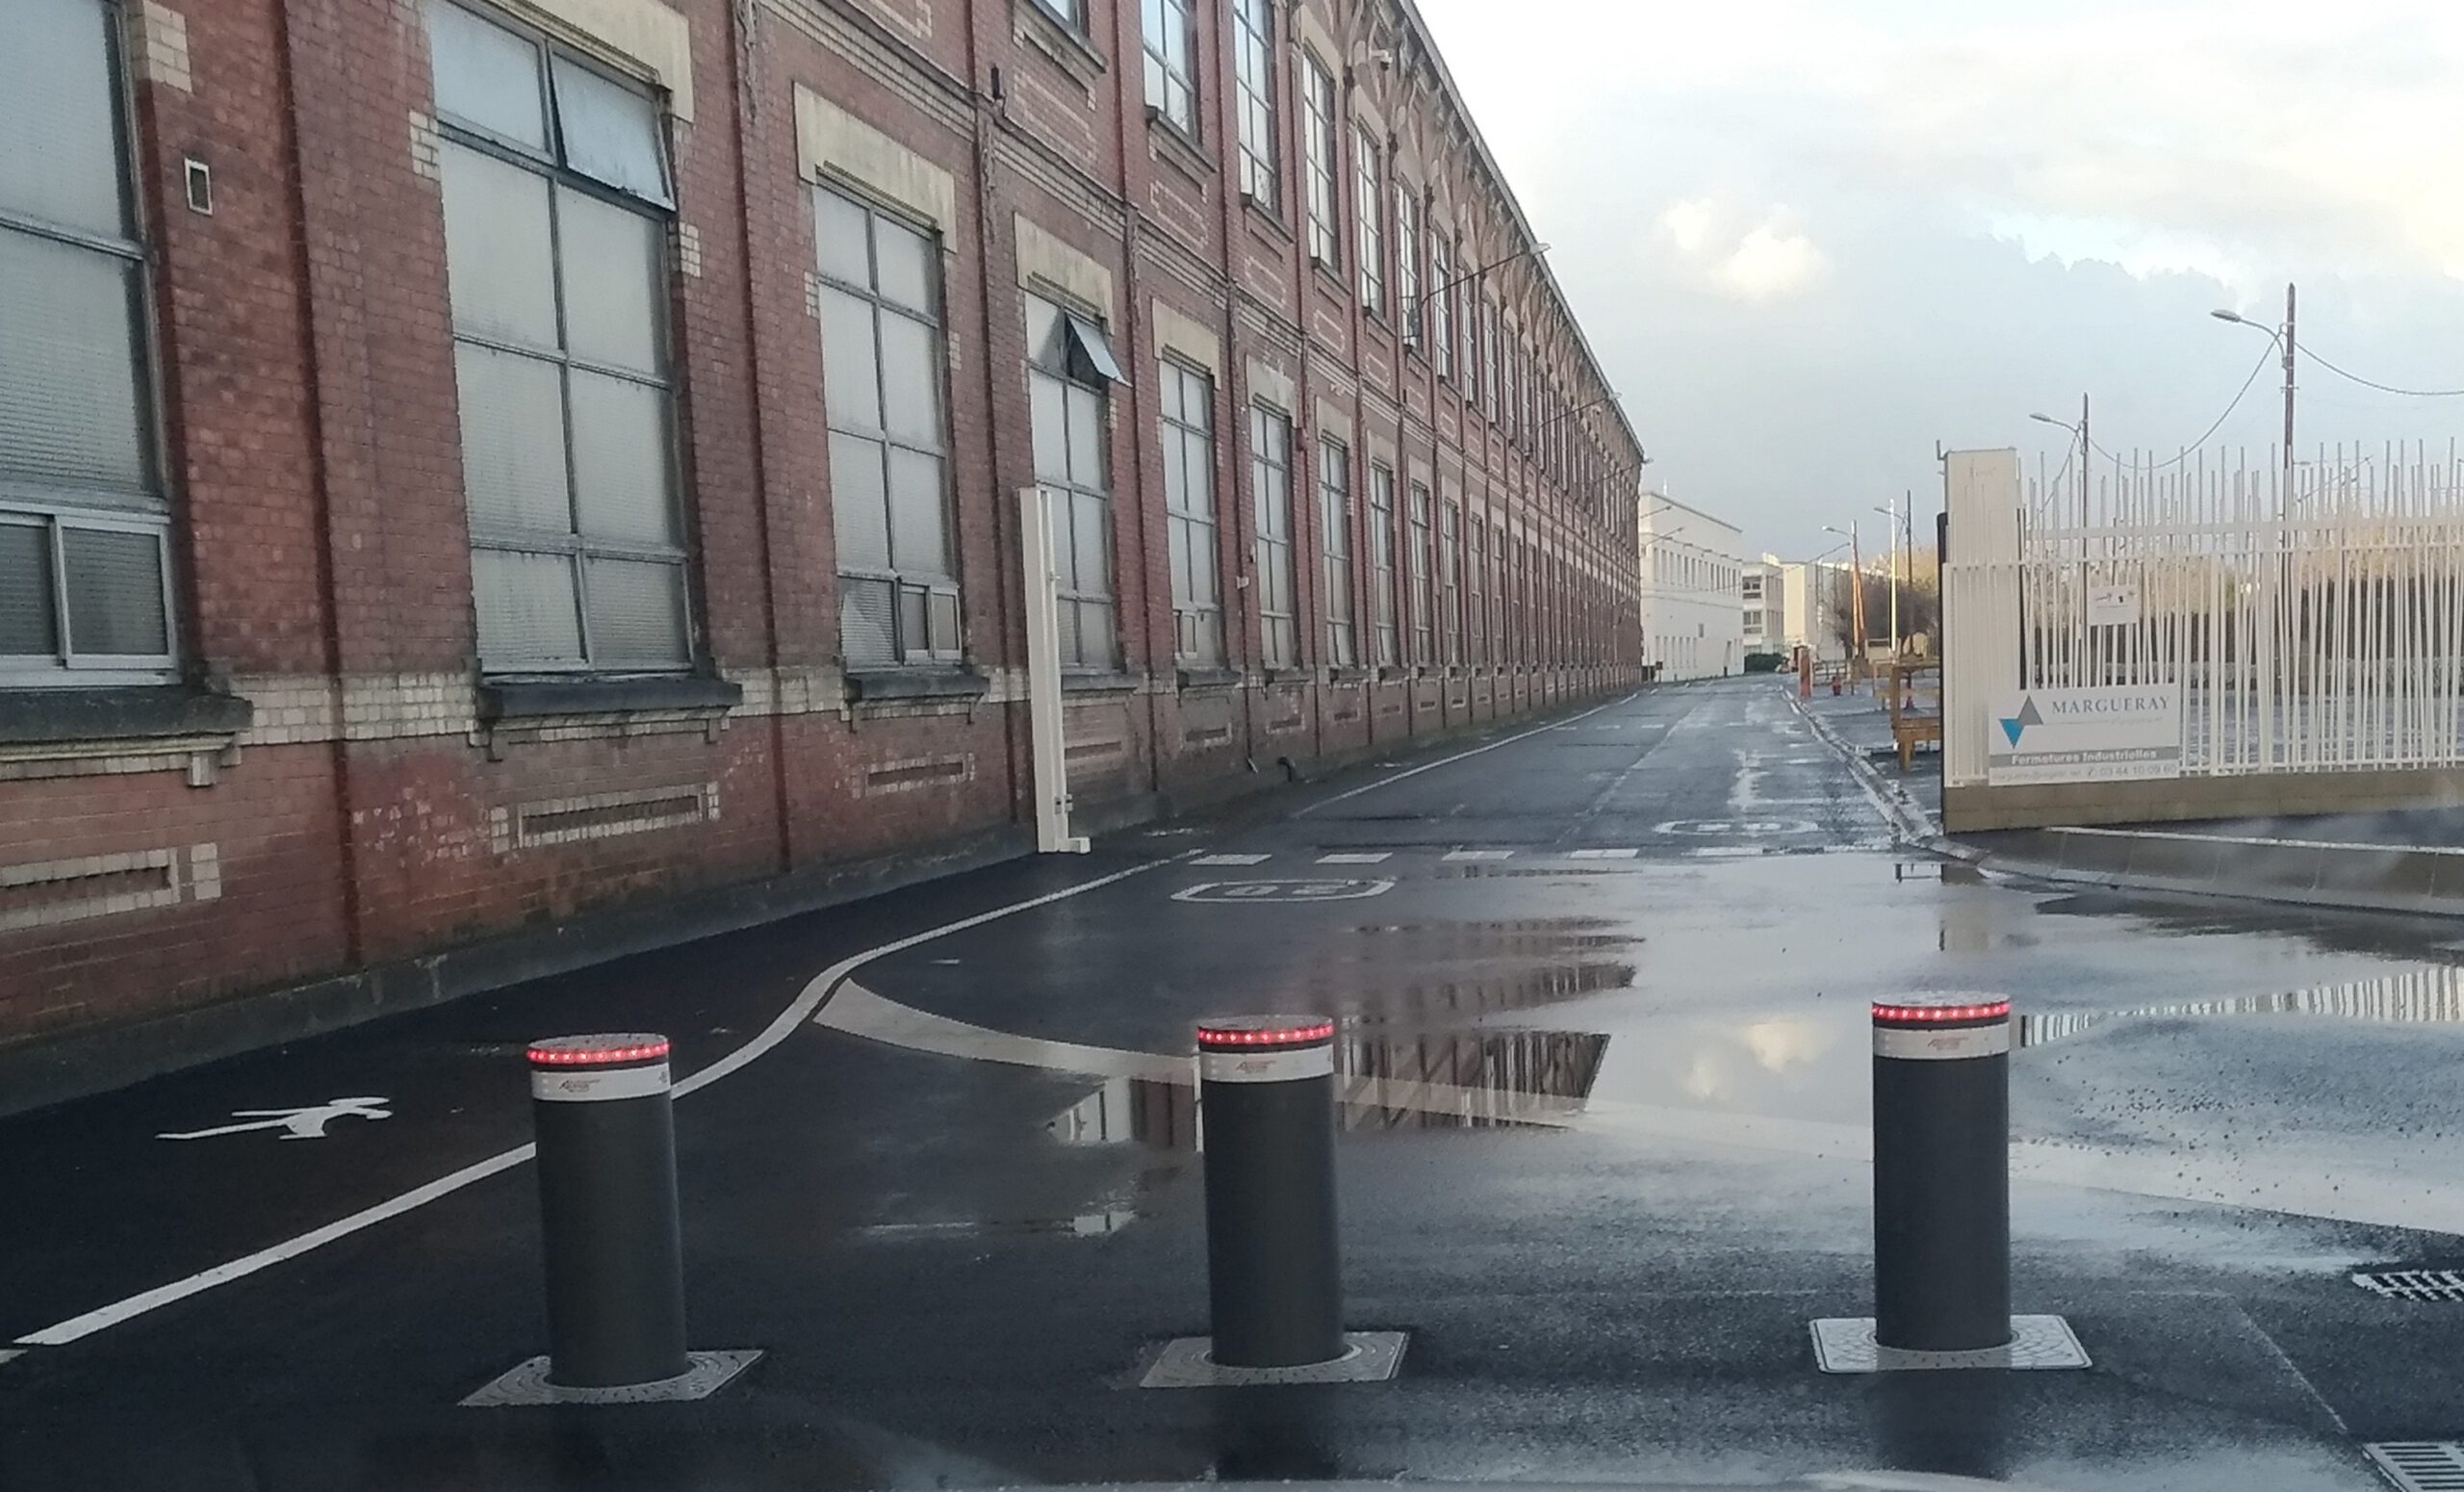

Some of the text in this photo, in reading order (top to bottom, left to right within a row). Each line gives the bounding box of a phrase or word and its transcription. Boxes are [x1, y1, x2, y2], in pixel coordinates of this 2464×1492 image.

[2052, 696, 2170, 714] MARGUERAY
[2012, 750, 2156, 765] Fermetures Industrielles
